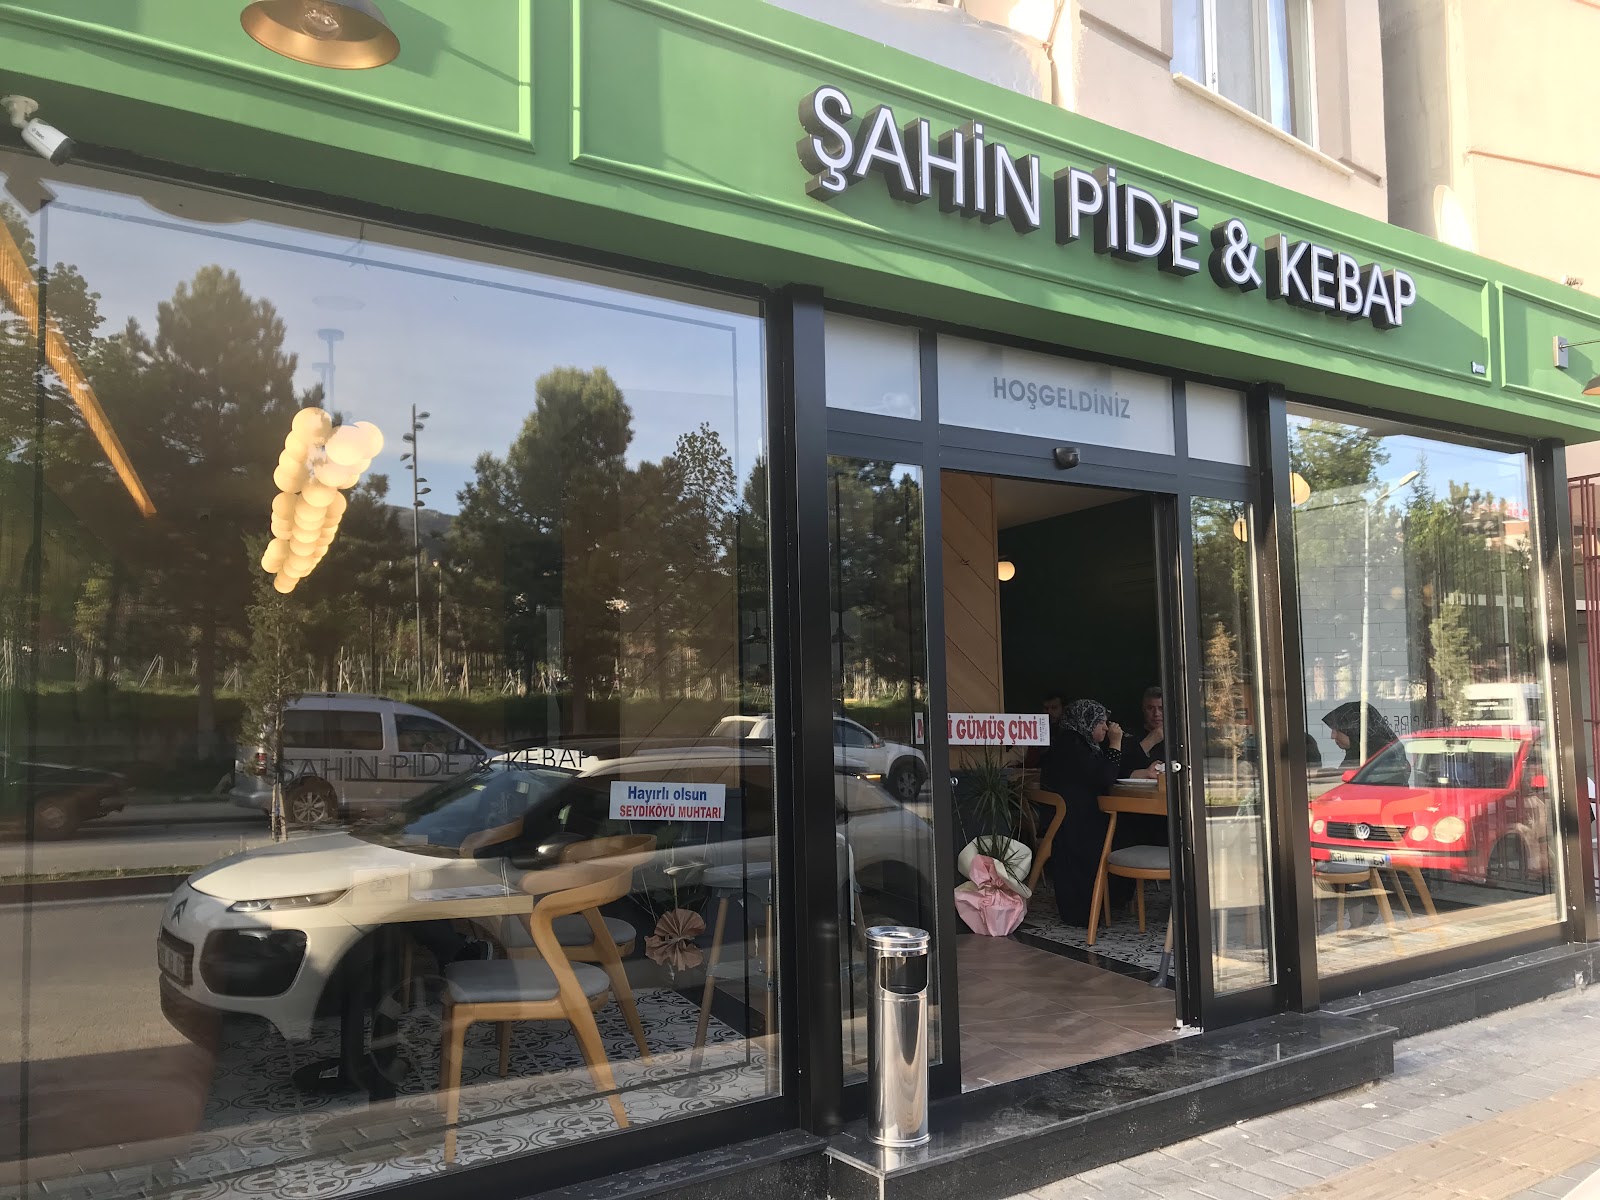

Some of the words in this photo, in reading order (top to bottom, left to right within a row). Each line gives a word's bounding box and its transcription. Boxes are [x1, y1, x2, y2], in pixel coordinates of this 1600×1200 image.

[810, 85, 1040, 228] ŞAHİN
[1067, 166, 1201, 272] PİDE
[1224, 218, 1263, 288] &
[1280, 233, 1416, 327] KEBAP
[993, 376, 1131, 419] HOŞGELDİNİZ
[956, 715, 1005, 744] GÜMÜŞ
[1008, 715, 1038, 744] ÇİNİ
[627, 785, 669, 804] Hayırlı
[673, 786, 707, 801] olsun
[619, 803, 676, 818] SEYDİKÖYÜ
[678, 806, 722, 819] MUHTARI
